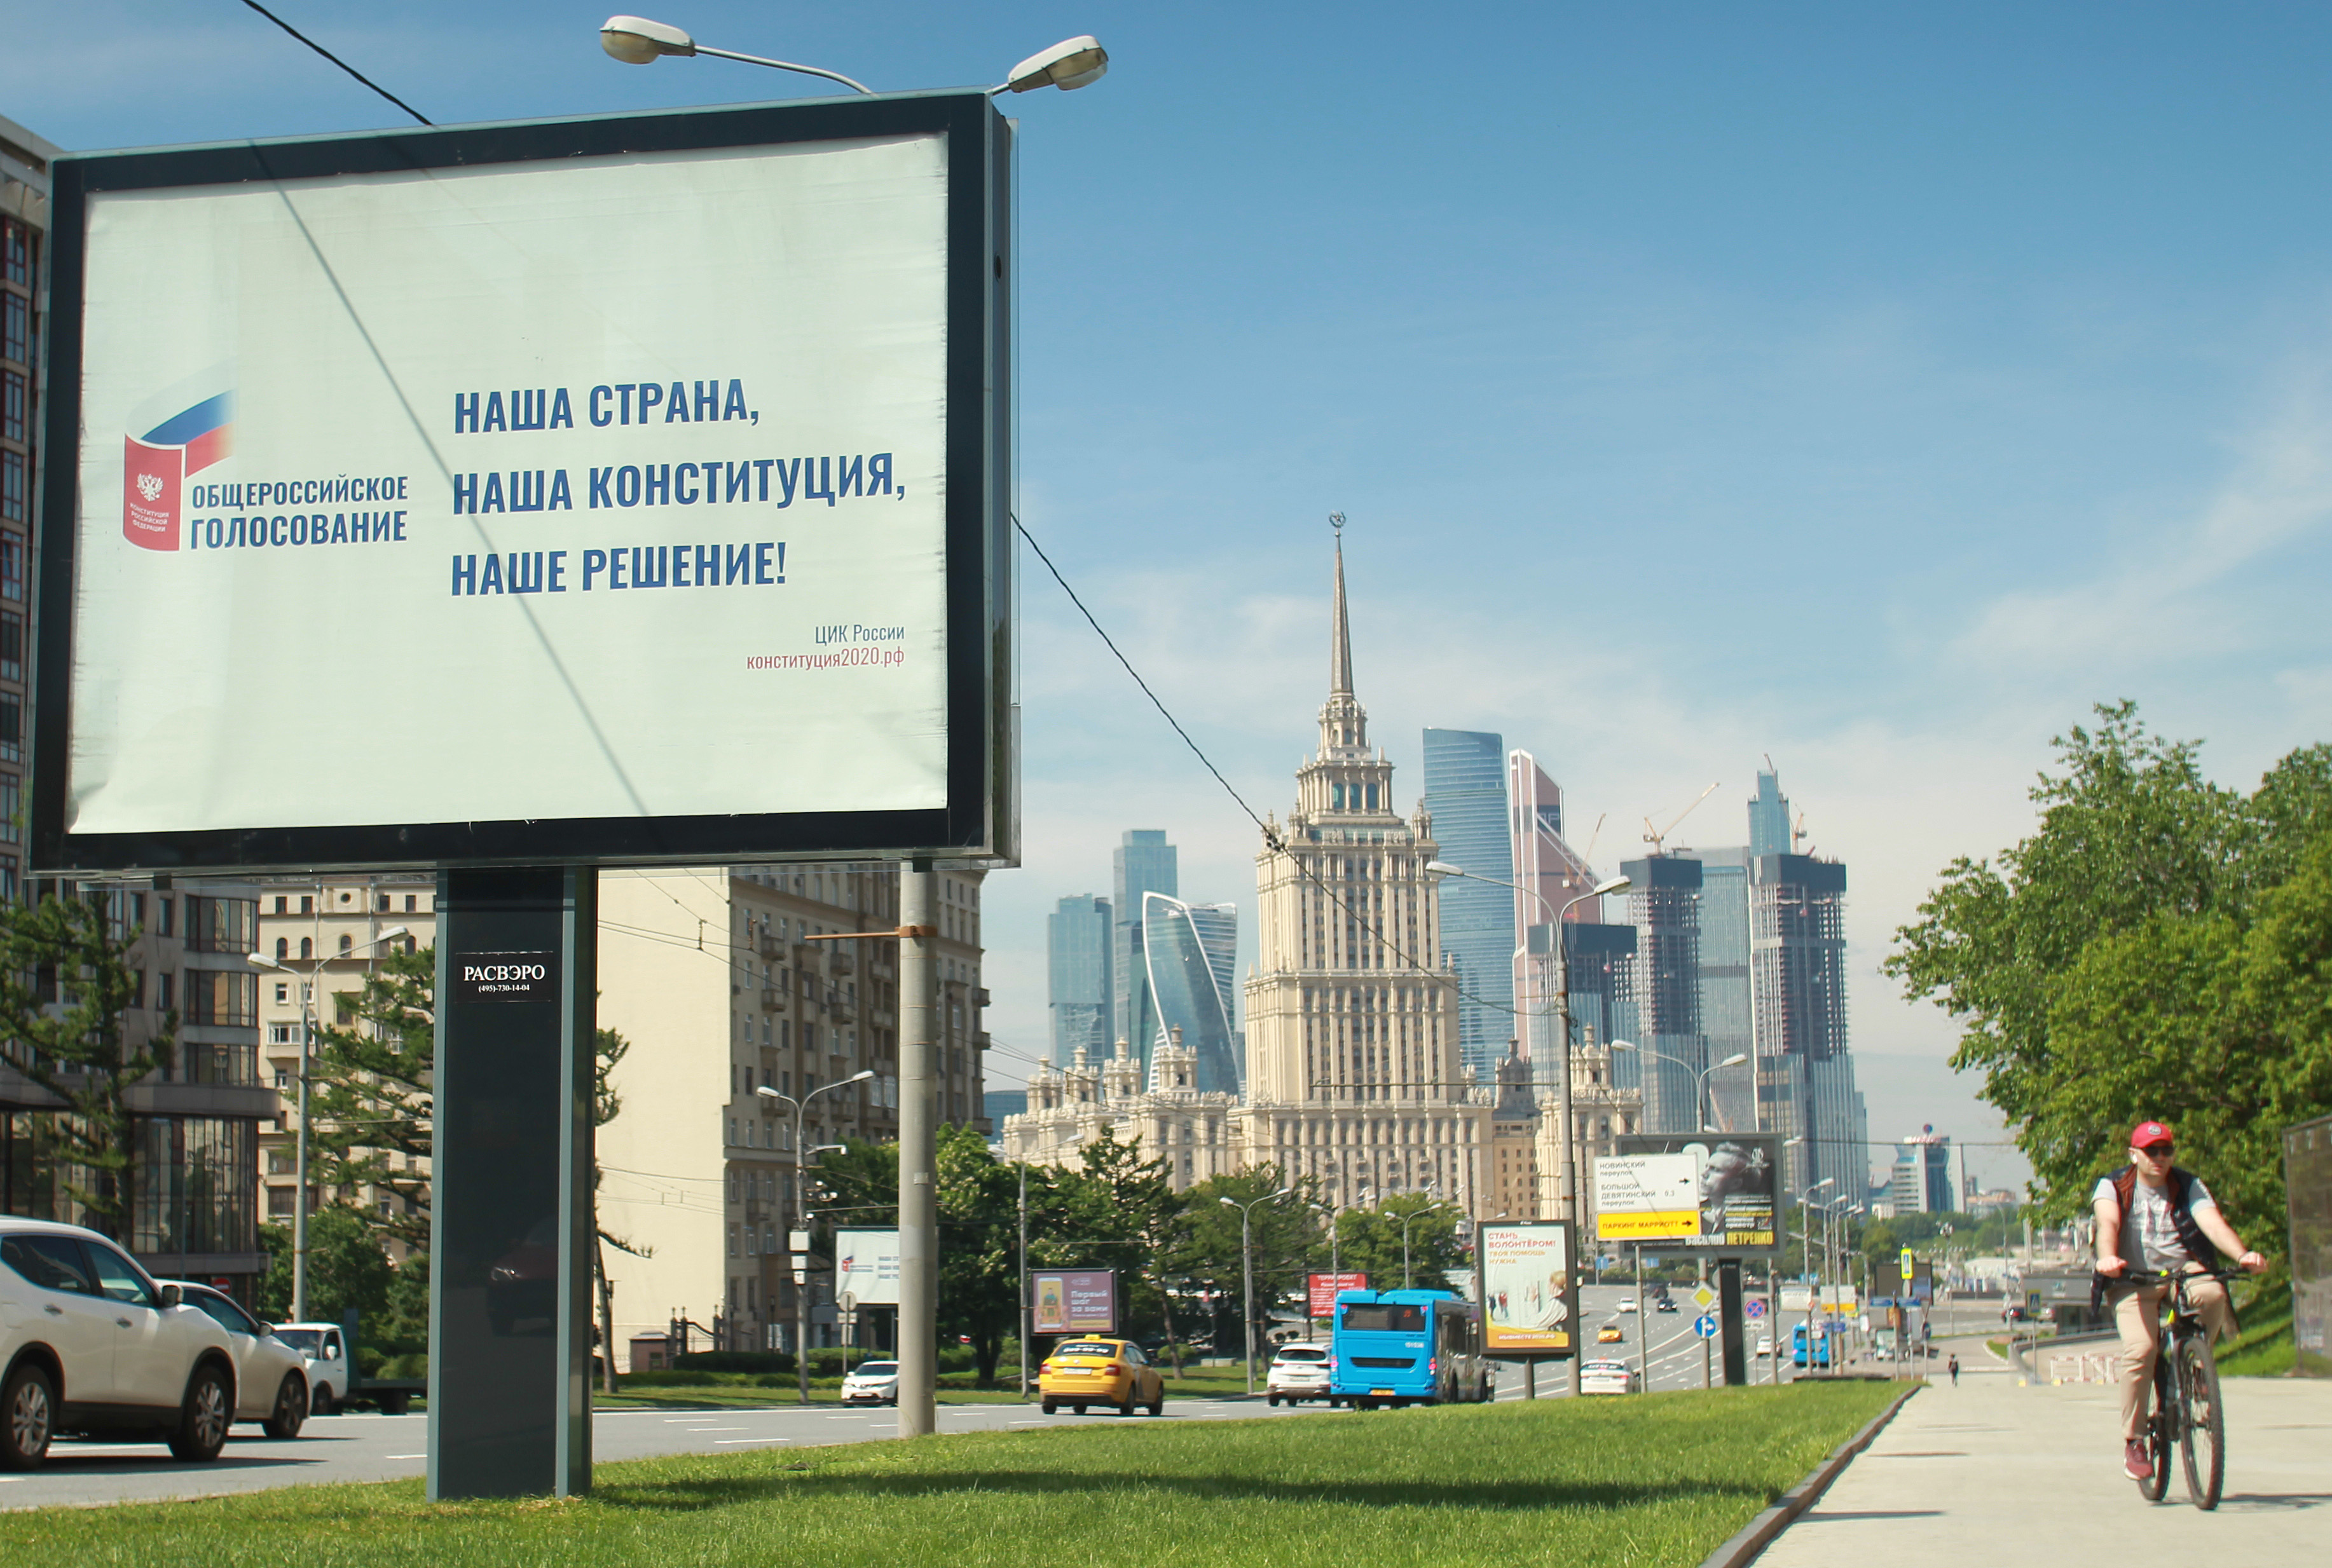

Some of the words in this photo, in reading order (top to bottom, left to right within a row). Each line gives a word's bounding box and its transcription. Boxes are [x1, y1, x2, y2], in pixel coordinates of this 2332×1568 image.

[455, 388, 573, 434] НАША
[589, 379, 758, 426] СТРАНА,
[192, 474, 409, 511] ОБЩЕРОССИЙСКОЕ
[453, 469, 572, 515] НАША
[588, 453, 905, 508] КОНСТИТУЦИЯ,
[191, 510, 408, 550] ГОЛОСОВАНИЕ
[451, 550, 567, 596] НАШЕ
[582, 542, 786, 591] РЕШЕНИЕ!
[815, 625, 848, 646] ЦИК
[853, 624, 905, 642] России
[746, 646, 905, 671] конституция2020.рф
[463, 964, 545, 981] РАСВЭРО
[478, 985, 530, 993] (495)-730-14-04
[1602, 1190, 1656, 1199] ДЕВЯТИНСКИЙ
[1488, 1239, 1556, 1248] ВОЛОНТЁРОМ!
[1727, 1231, 1774, 1245] ПЕТРЕНКО
[1071, 1290, 1108, 1299] Первый
